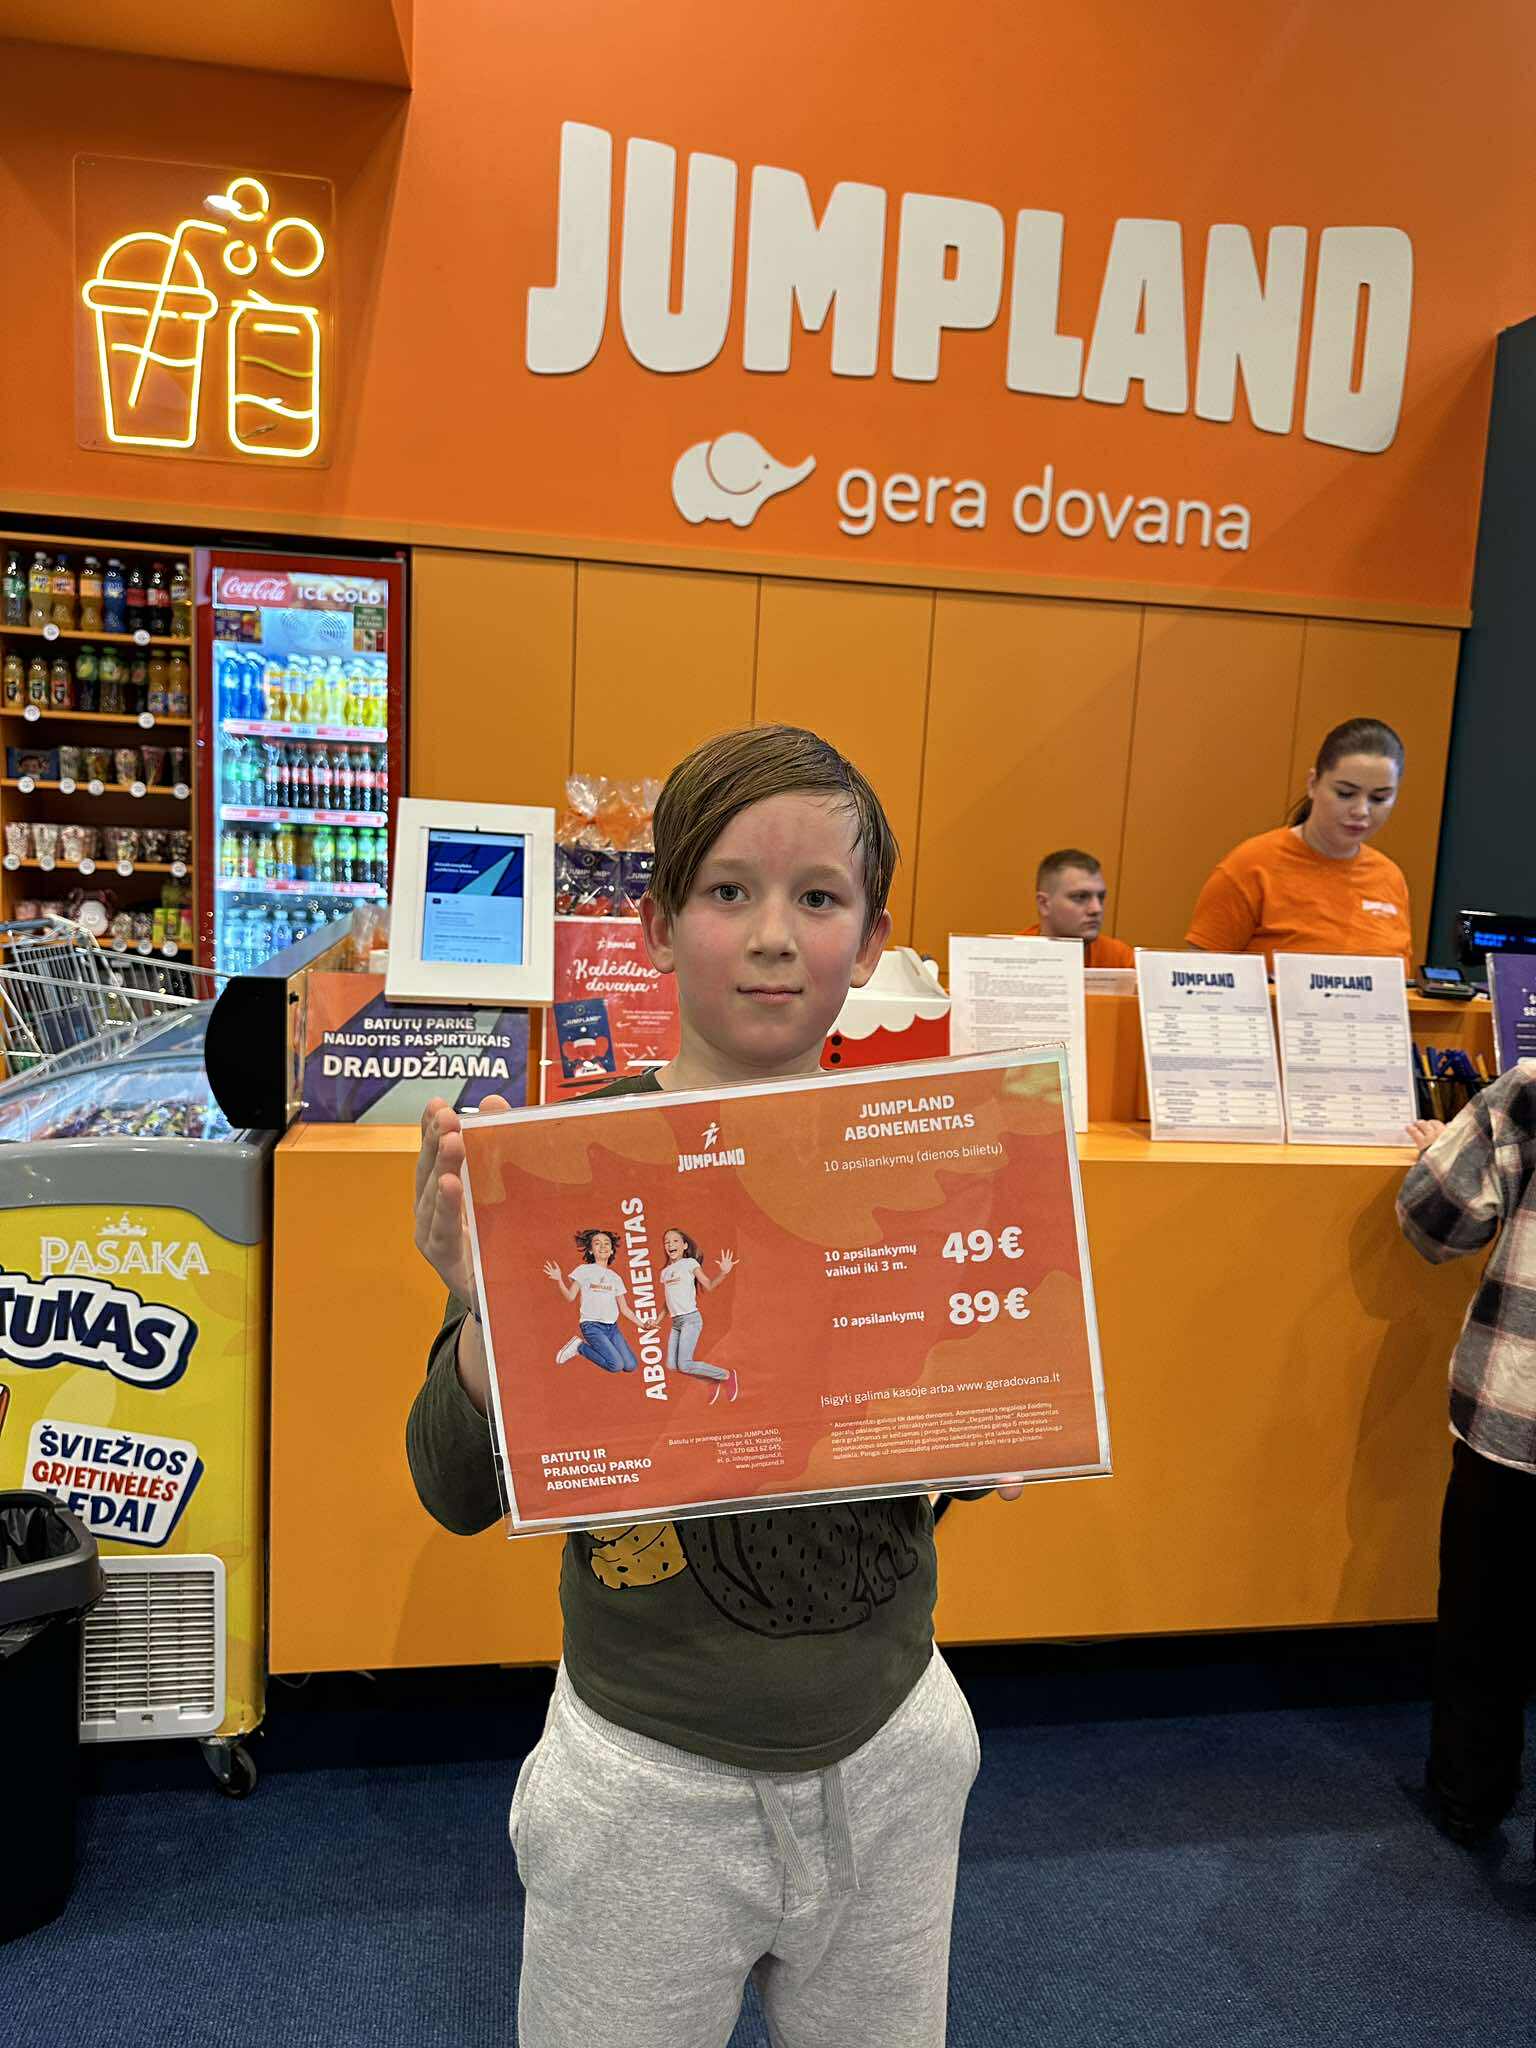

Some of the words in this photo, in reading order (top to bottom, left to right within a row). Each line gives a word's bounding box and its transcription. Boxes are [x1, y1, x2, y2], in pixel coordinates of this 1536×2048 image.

[525, 121, 1415, 454] JUMPLAND
[836, 468, 988, 536] gera
[1012, 465, 1252, 551] dovana
[333, 587, 381, 605] COLD
[585, 977, 651, 992] dovana
[1172, 970, 1235, 988] JUMPLAND
[1310, 973, 1373, 991] JUMPLAND
[363, 1017, 423, 1033] BATUTŲ
[426, 1017, 476, 1031] PARKE
[323, 1031, 401, 1047] NAUDOTIS
[404, 1033, 511, 1048] PASPIRTUKAIS
[322, 1052, 510, 1079] DRAUDŽIAMA
[859, 1094, 955, 1119] JUMPLAND
[844, 1113, 976, 1141] ABONEMENTAS
[677, 1147, 746, 1173] JUMPLAND
[824, 1160, 839, 1172] 10
[841, 1155, 914, 1171] apsilankymų
[916, 1148, 960, 1163] (dienos
[40, 1236, 211, 1280] PASAKA
[824, 1250, 840, 1262] 10
[843, 1243, 917, 1261] apsilankymų
[825, 1264, 861, 1278] vaikui
[864, 1260, 879, 1273] iki
[881, 1260, 889, 1272] 3
[892, 1261, 908, 1271] m.
[621, 1197, 668, 1401] ABONEMENTAS
[832, 1316, 848, 1329] 10
[850, 1310, 925, 1328] apsilankymų
[854, 1389, 890, 1404] galima
[893, 1386, 928, 1400] kasoje
[930, 1382, 955, 1395] arba
[956, 1372, 1061, 1393] www.geradovana.lt
[39, 1425, 188, 1475] ŠVIEŽIOS
[541, 1449, 591, 1465] BATUTŲ
[593, 1448, 607, 1459] IR
[543, 1462, 607, 1478] PRAMOGŲ
[609, 1458, 652, 1471] PARKO
[32, 1460, 178, 1502] GRIETINĖLĖS
[546, 1473, 640, 1491] ABONEMENTAS
[46, 1488, 157, 1533] EDAI
